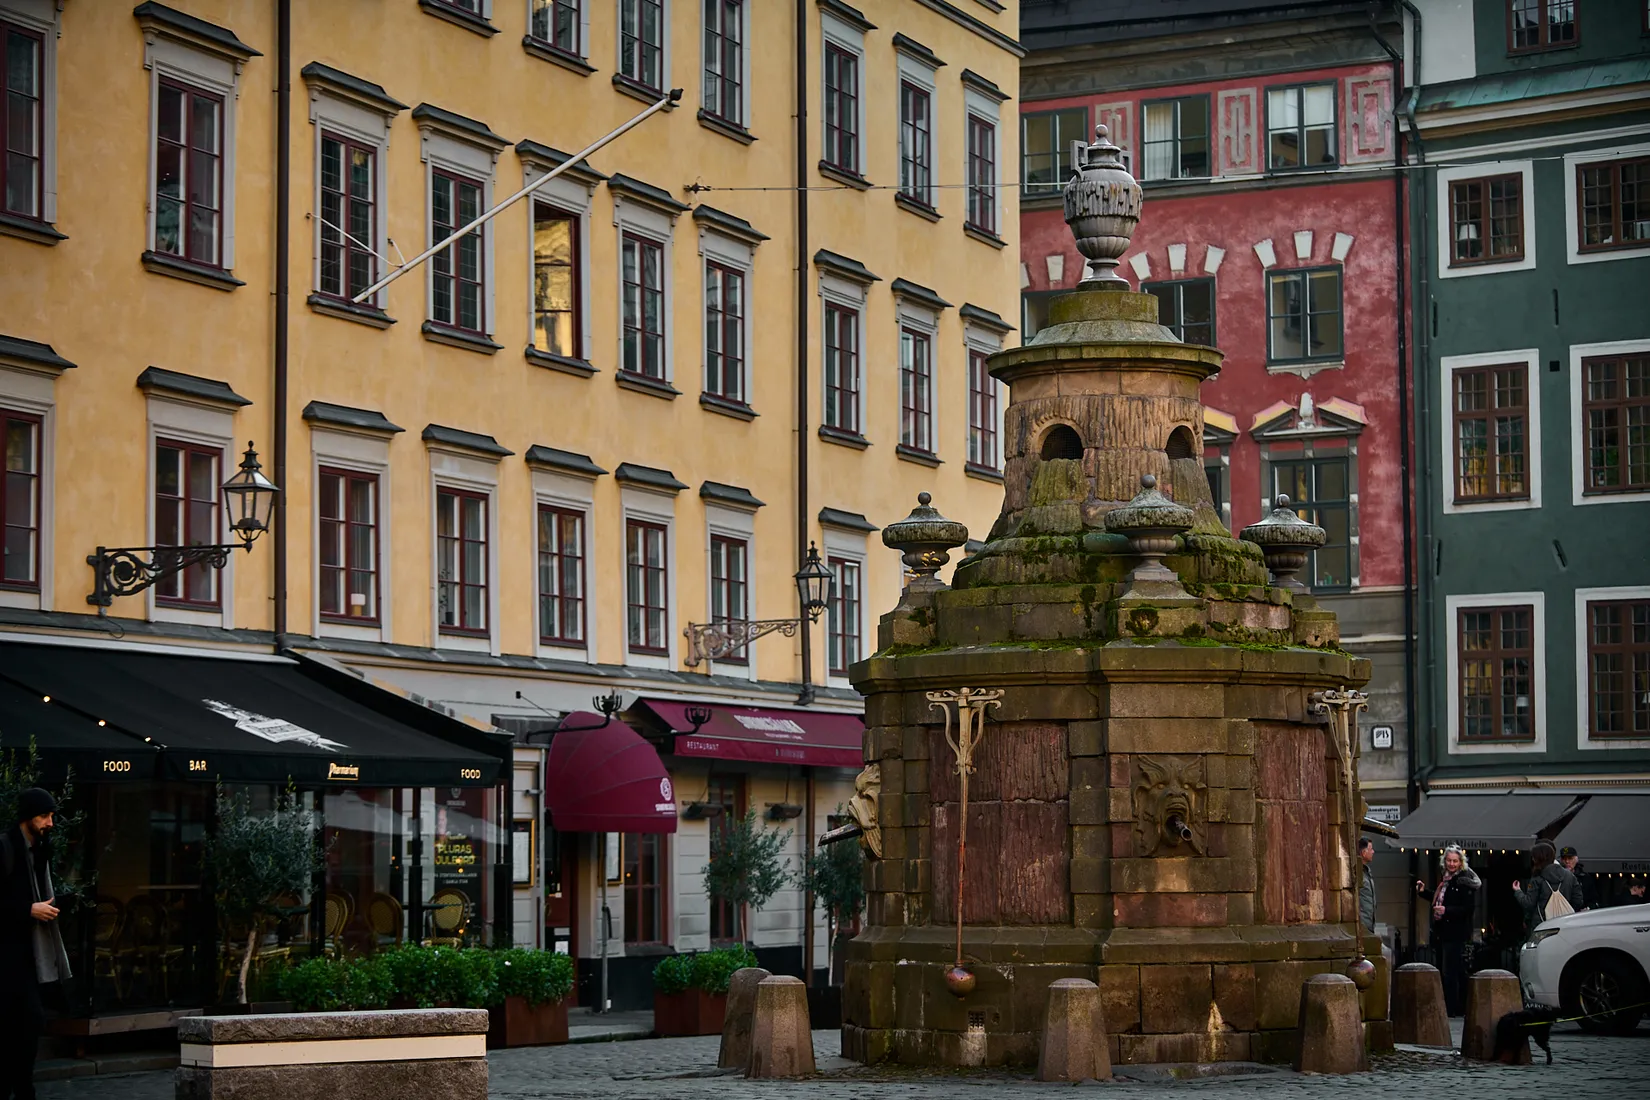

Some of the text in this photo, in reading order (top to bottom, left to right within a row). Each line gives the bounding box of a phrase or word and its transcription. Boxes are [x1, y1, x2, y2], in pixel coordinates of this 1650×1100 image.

[686, 741, 719, 750] RESTAURANT
[103, 761, 131, 772] FOOD
[189, 760, 207, 771] BAR
[461, 769, 481, 779] FOOD
[437, 844, 472, 855] PLURAS
